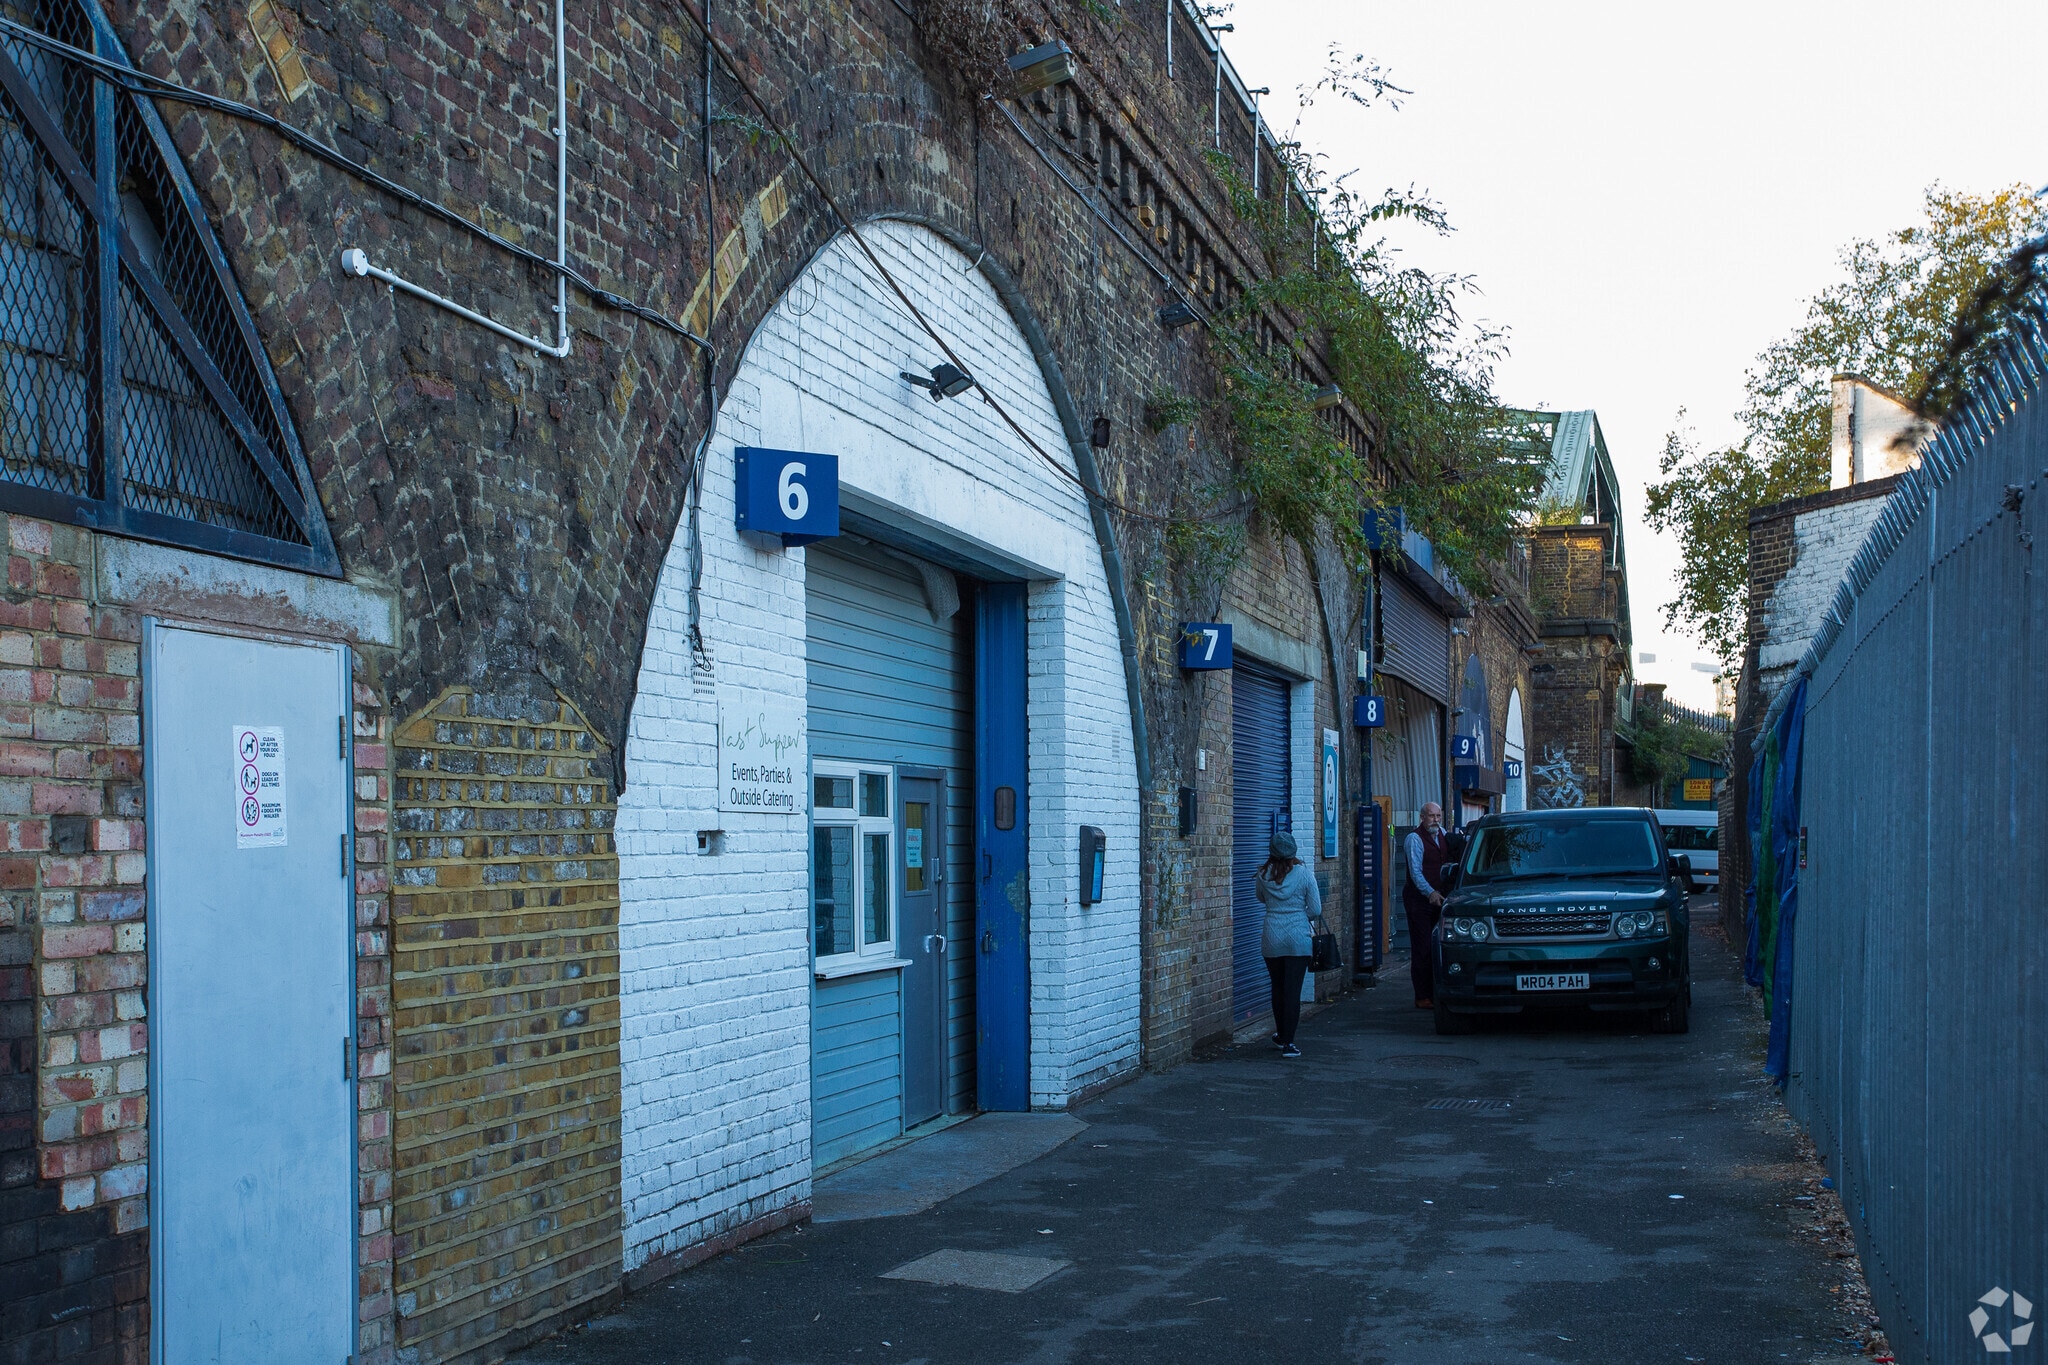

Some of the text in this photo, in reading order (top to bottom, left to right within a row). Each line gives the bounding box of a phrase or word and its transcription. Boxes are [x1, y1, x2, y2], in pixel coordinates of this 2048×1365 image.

[778, 462, 809, 520] 6
[1203, 629, 1219, 661] 7
[1367, 700, 1377, 722] 8
[758, 712, 800, 762] Supper
[1461, 739, 1469, 754] 9
[732, 763, 792, 784] Events, Parties &
[1508, 764, 1519, 776] 10
[730, 787, 794, 811] Outside Catering
[1558, 975, 1584, 988] PAH
